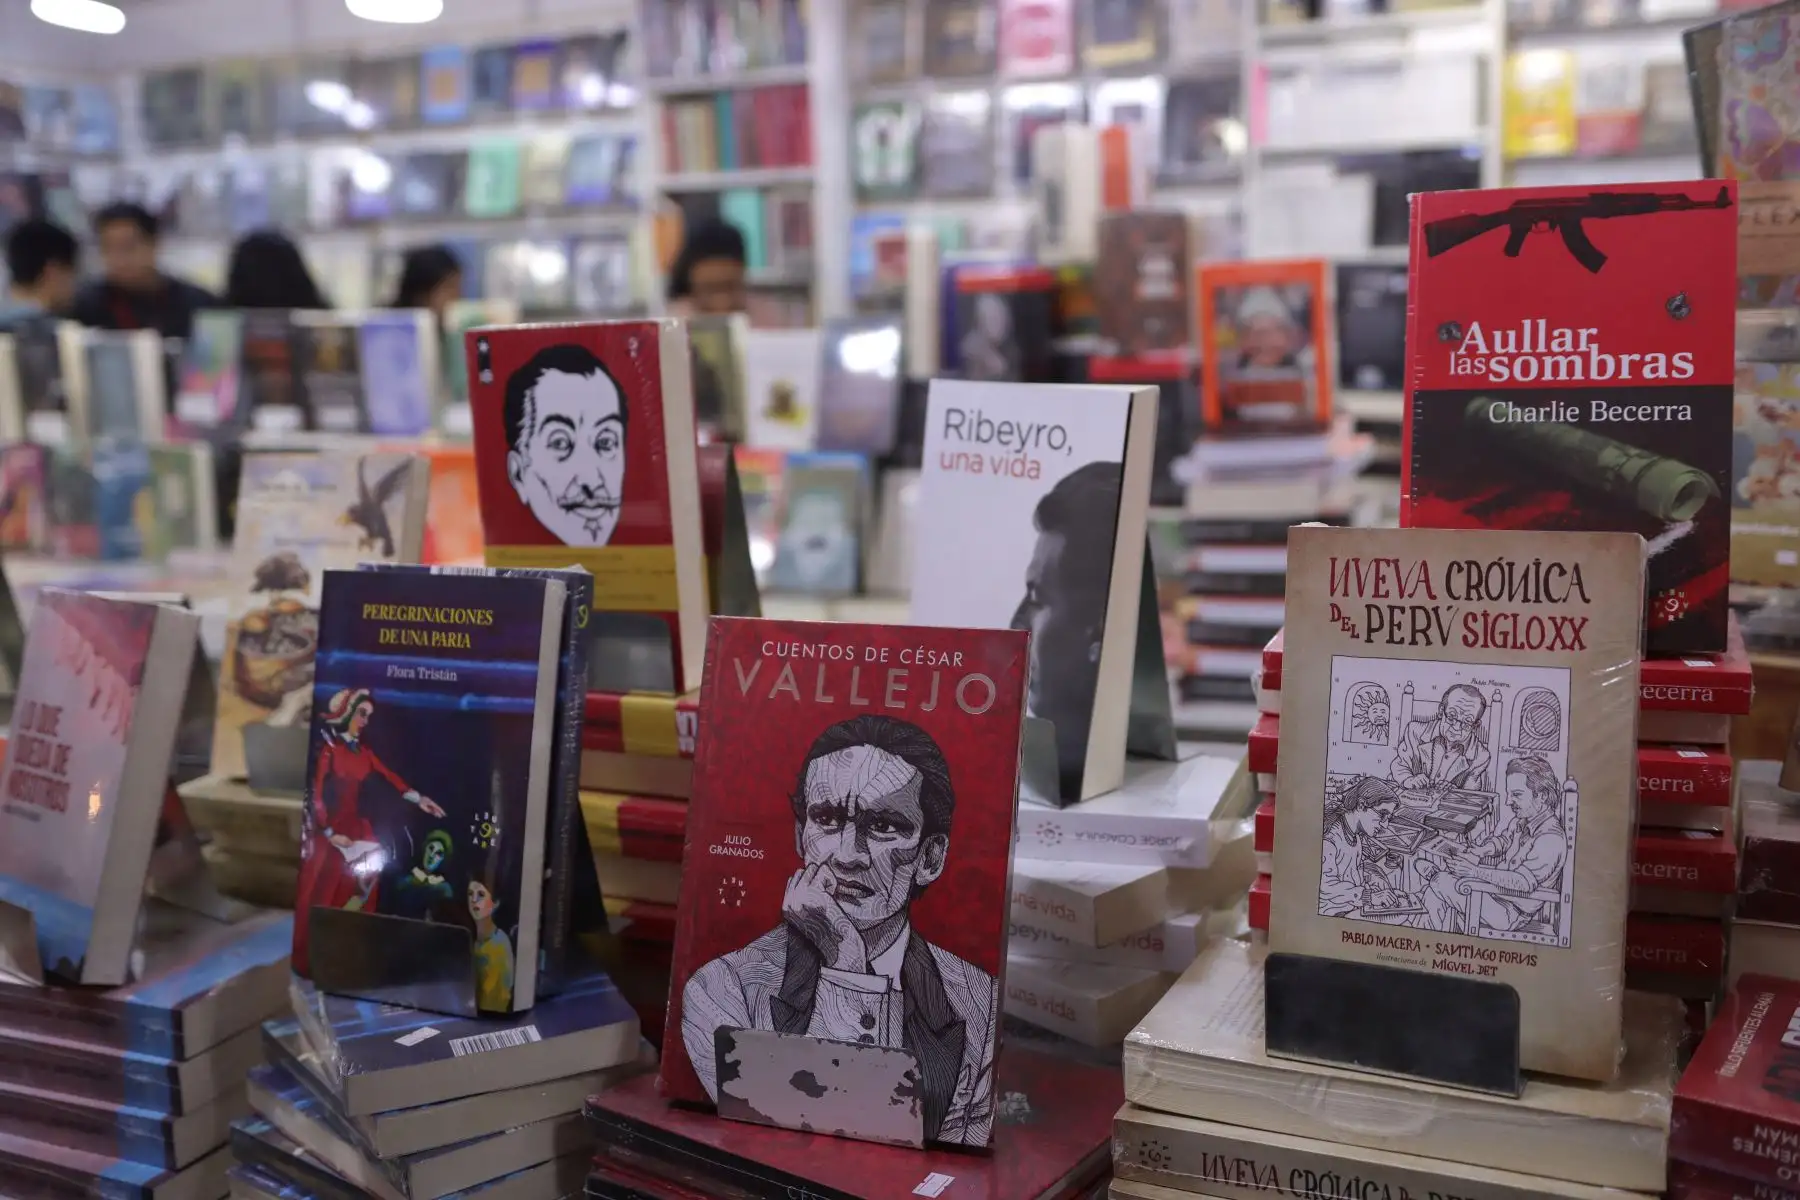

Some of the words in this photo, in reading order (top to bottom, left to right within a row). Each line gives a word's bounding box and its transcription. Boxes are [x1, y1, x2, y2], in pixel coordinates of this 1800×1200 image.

[1457, 319, 1598, 354] Aullar
[1449, 352, 1487, 376] las
[1488, 344, 1695, 382] sombras
[1488, 401, 1580, 423] Charlie
[1590, 400, 1692, 422] Becerra
[943, 408, 1072, 456] Ribeyro,
[940, 451, 983, 474] una
[990, 452, 1041, 480] vida
[1445, 557, 1591, 604] CRÓNICA
[363, 603, 494, 626] PEREGRINACIONES
[1329, 603, 1360, 639] DEL
[378, 628, 400, 645] DE
[401, 629, 429, 647] UNA
[431, 631, 472, 649] PARIA
[762, 641, 854, 660] CUENTOS
[865, 647, 889, 663] DE
[900, 646, 964, 667] CÉSAR
[386, 664, 415, 680] Flora
[417, 667, 458, 682] Tristán
[734, 657, 997, 715] VALLEJO
[1639, 686, 1713, 702] ecerra
[1636, 776, 1694, 793] cerra
[724, 834, 751, 846] JULIO
[709, 844, 765, 860] GRANADOS
[1341, 931, 1374, 946] PABLO
[1376, 935, 1421, 952] MACERA
[1435, 943, 1497, 962] SANTIAGO
[1499, 951, 1538, 967] FORNS
[1626, 945, 1687, 963] cerra
[1477, 965, 1498, 977] DET
